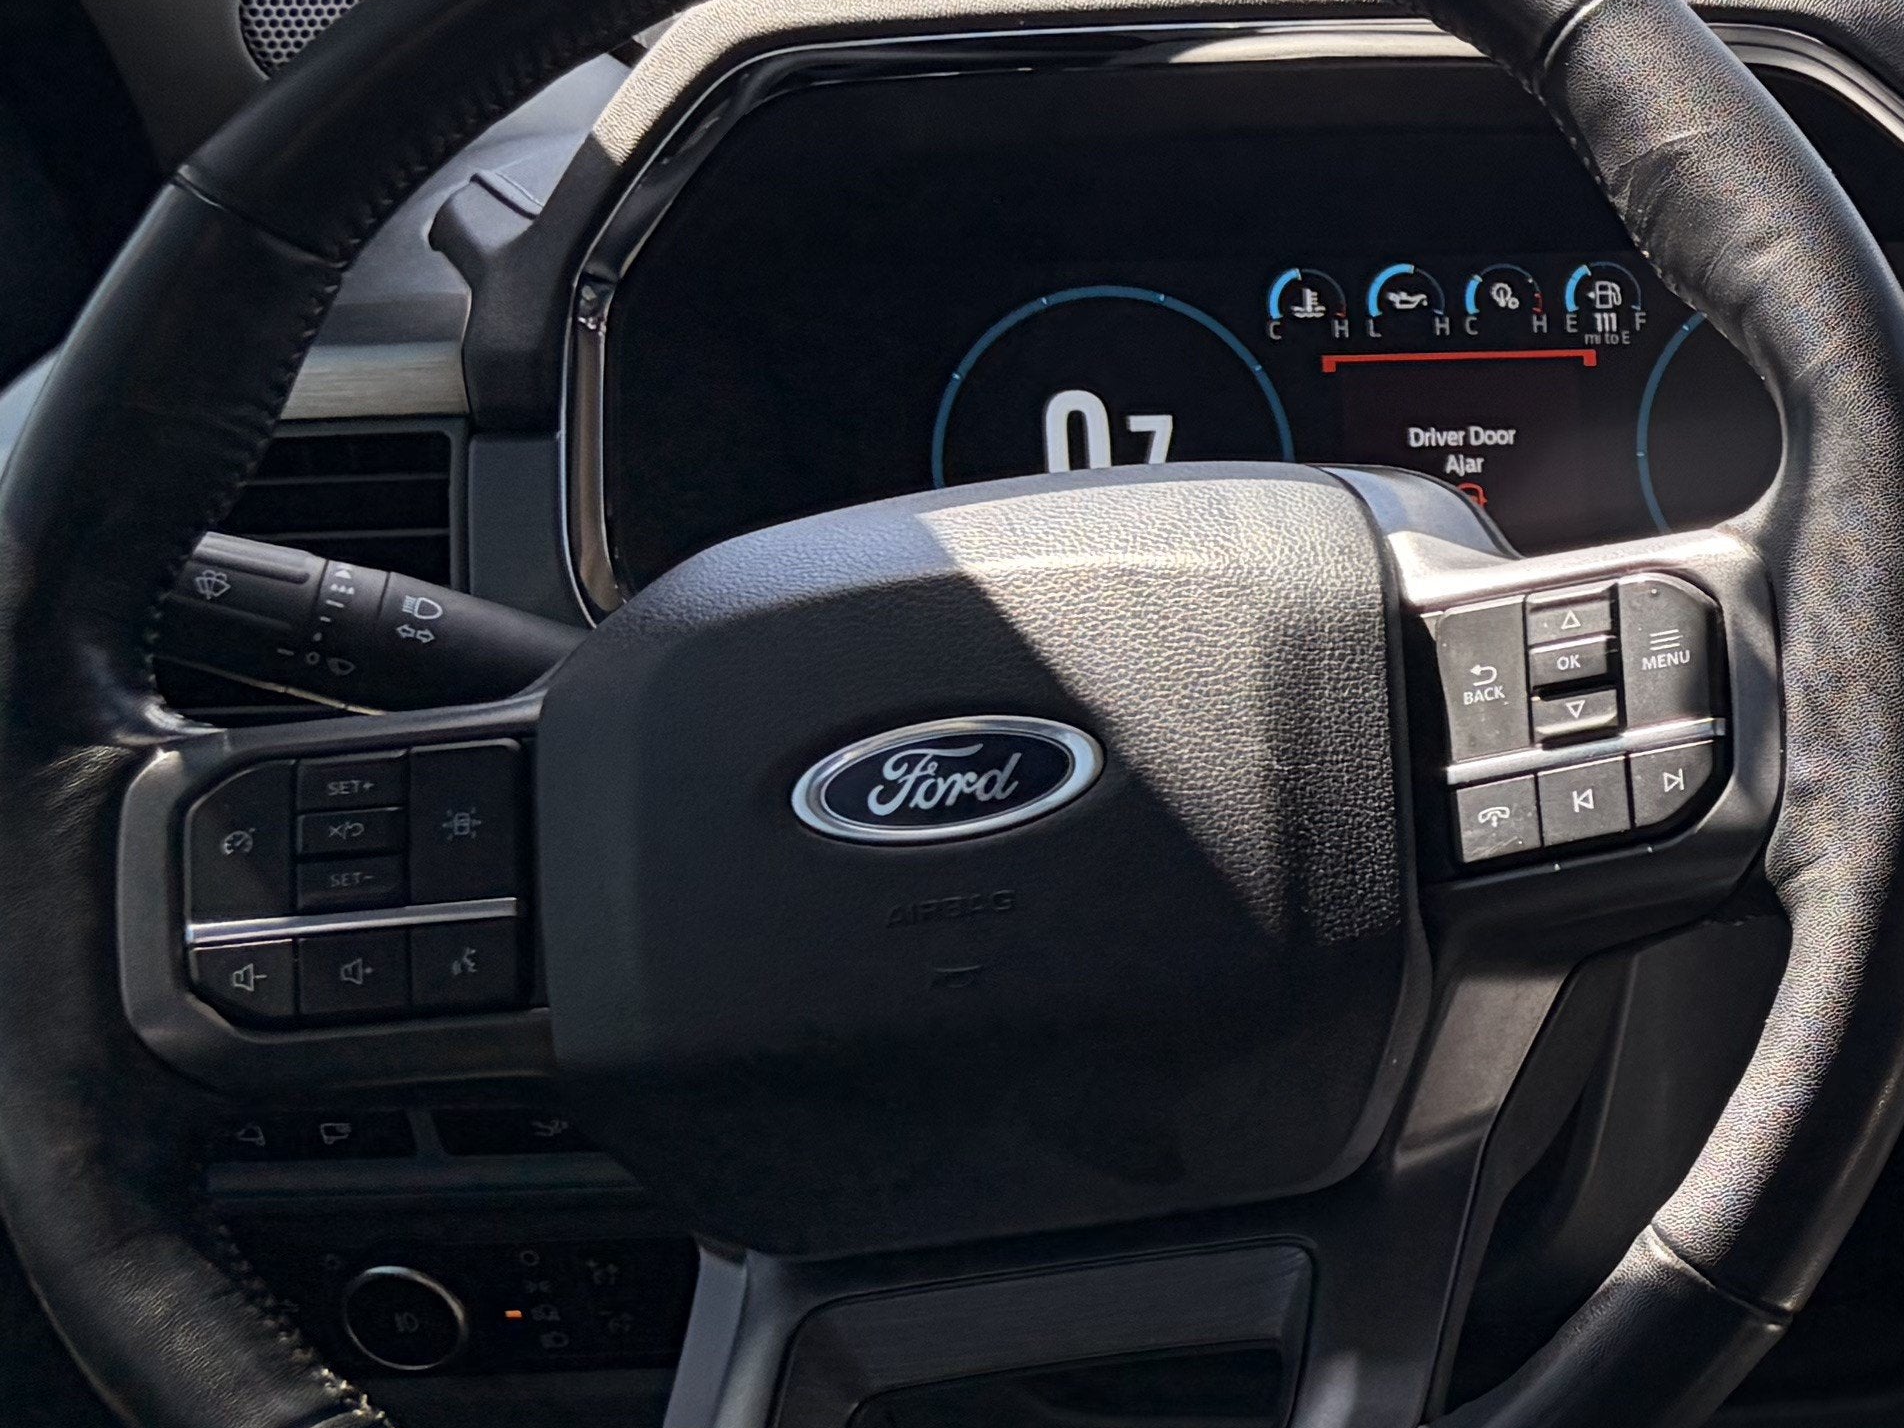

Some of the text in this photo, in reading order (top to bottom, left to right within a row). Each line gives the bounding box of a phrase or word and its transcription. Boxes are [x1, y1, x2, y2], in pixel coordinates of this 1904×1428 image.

[1267, 321, 1282, 341] C
[1332, 319, 1350, 338] H
[1367, 319, 1382, 338] L
[1434, 317, 1451, 336] H
[1464, 317, 1479, 336] C
[1532, 314, 1549, 334] H
[1565, 314, 1577, 333] E
[1593, 312, 1619, 332] 111
[1634, 312, 1647, 331] F
[1605, 332, 1620, 345] to
[1622, 331, 1631, 345] E
[1408, 425, 1516, 448] Driver Door
[1445, 453, 1485, 476] Ajar
[1556, 653, 1581, 671] OK
[1641, 649, 1691, 671] MENU
[1463, 684, 1505, 706] BACK
[867, 742, 1022, 817] Ford
